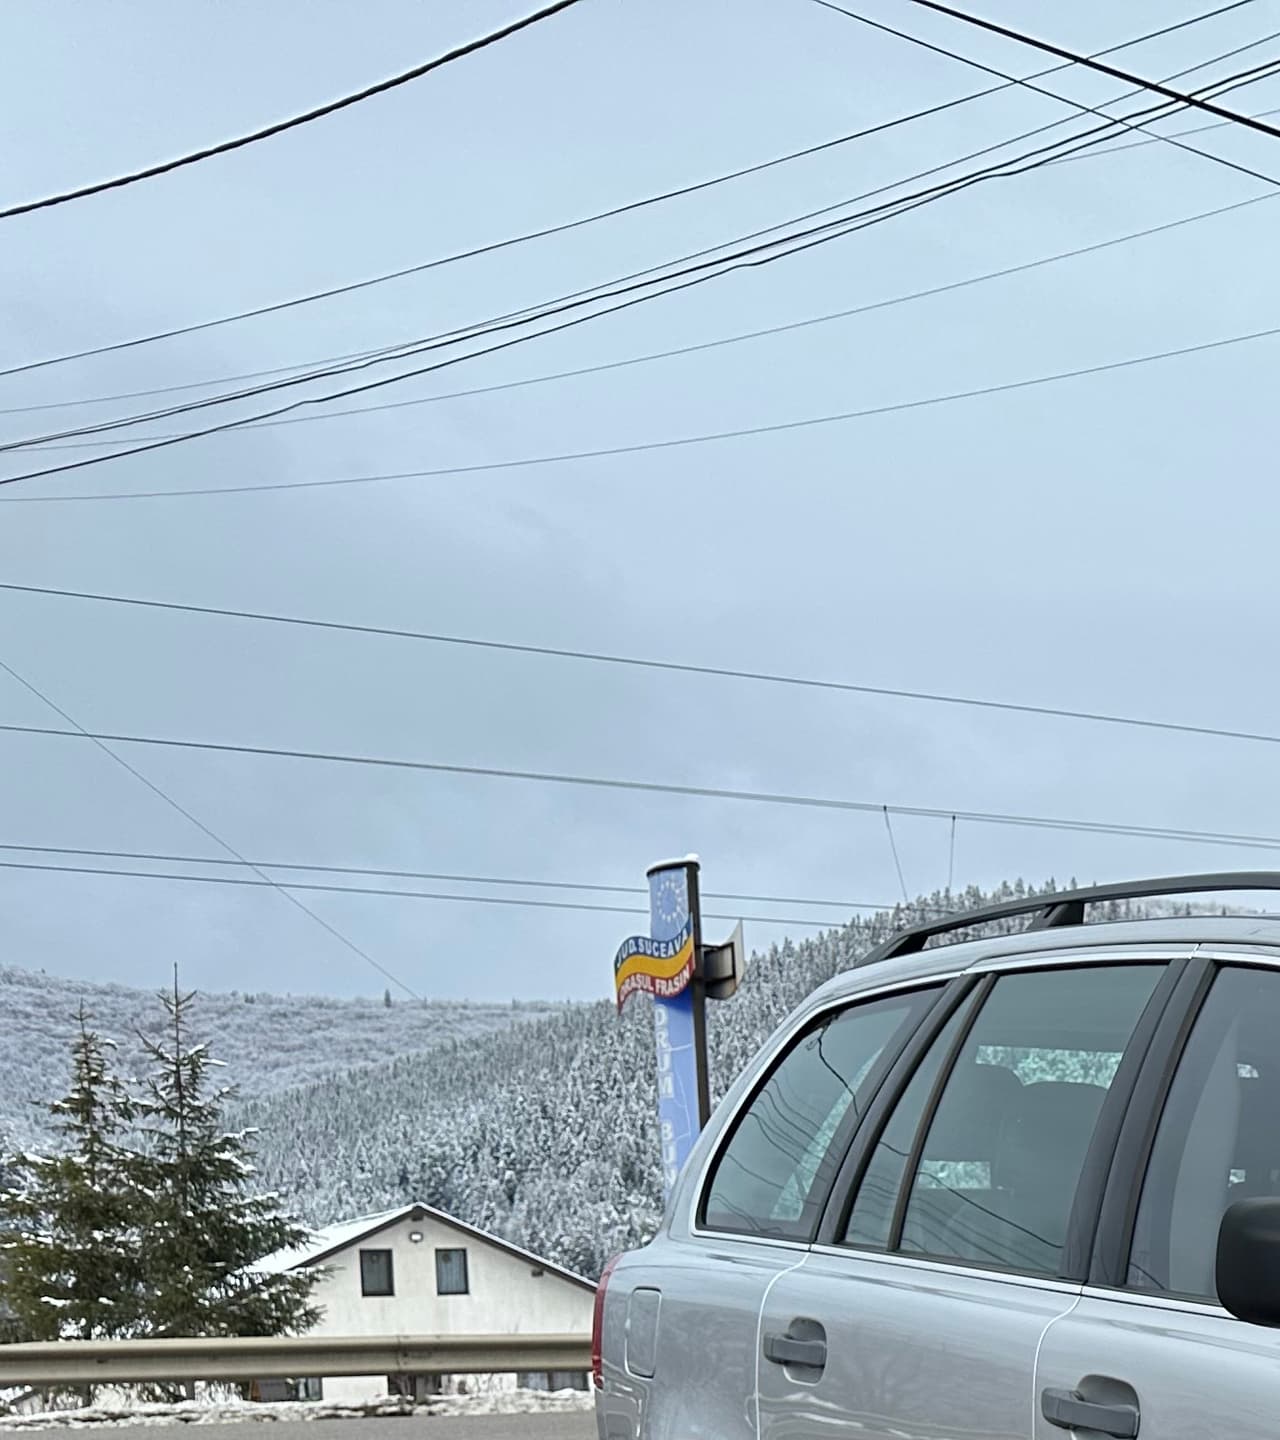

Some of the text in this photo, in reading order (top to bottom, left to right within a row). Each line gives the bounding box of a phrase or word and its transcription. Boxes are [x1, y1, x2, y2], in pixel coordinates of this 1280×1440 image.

[638, 928, 689, 957] SUCEAVA
[655, 963, 691, 996] FRASIN
[654, 1004, 675, 1098] DRUM
